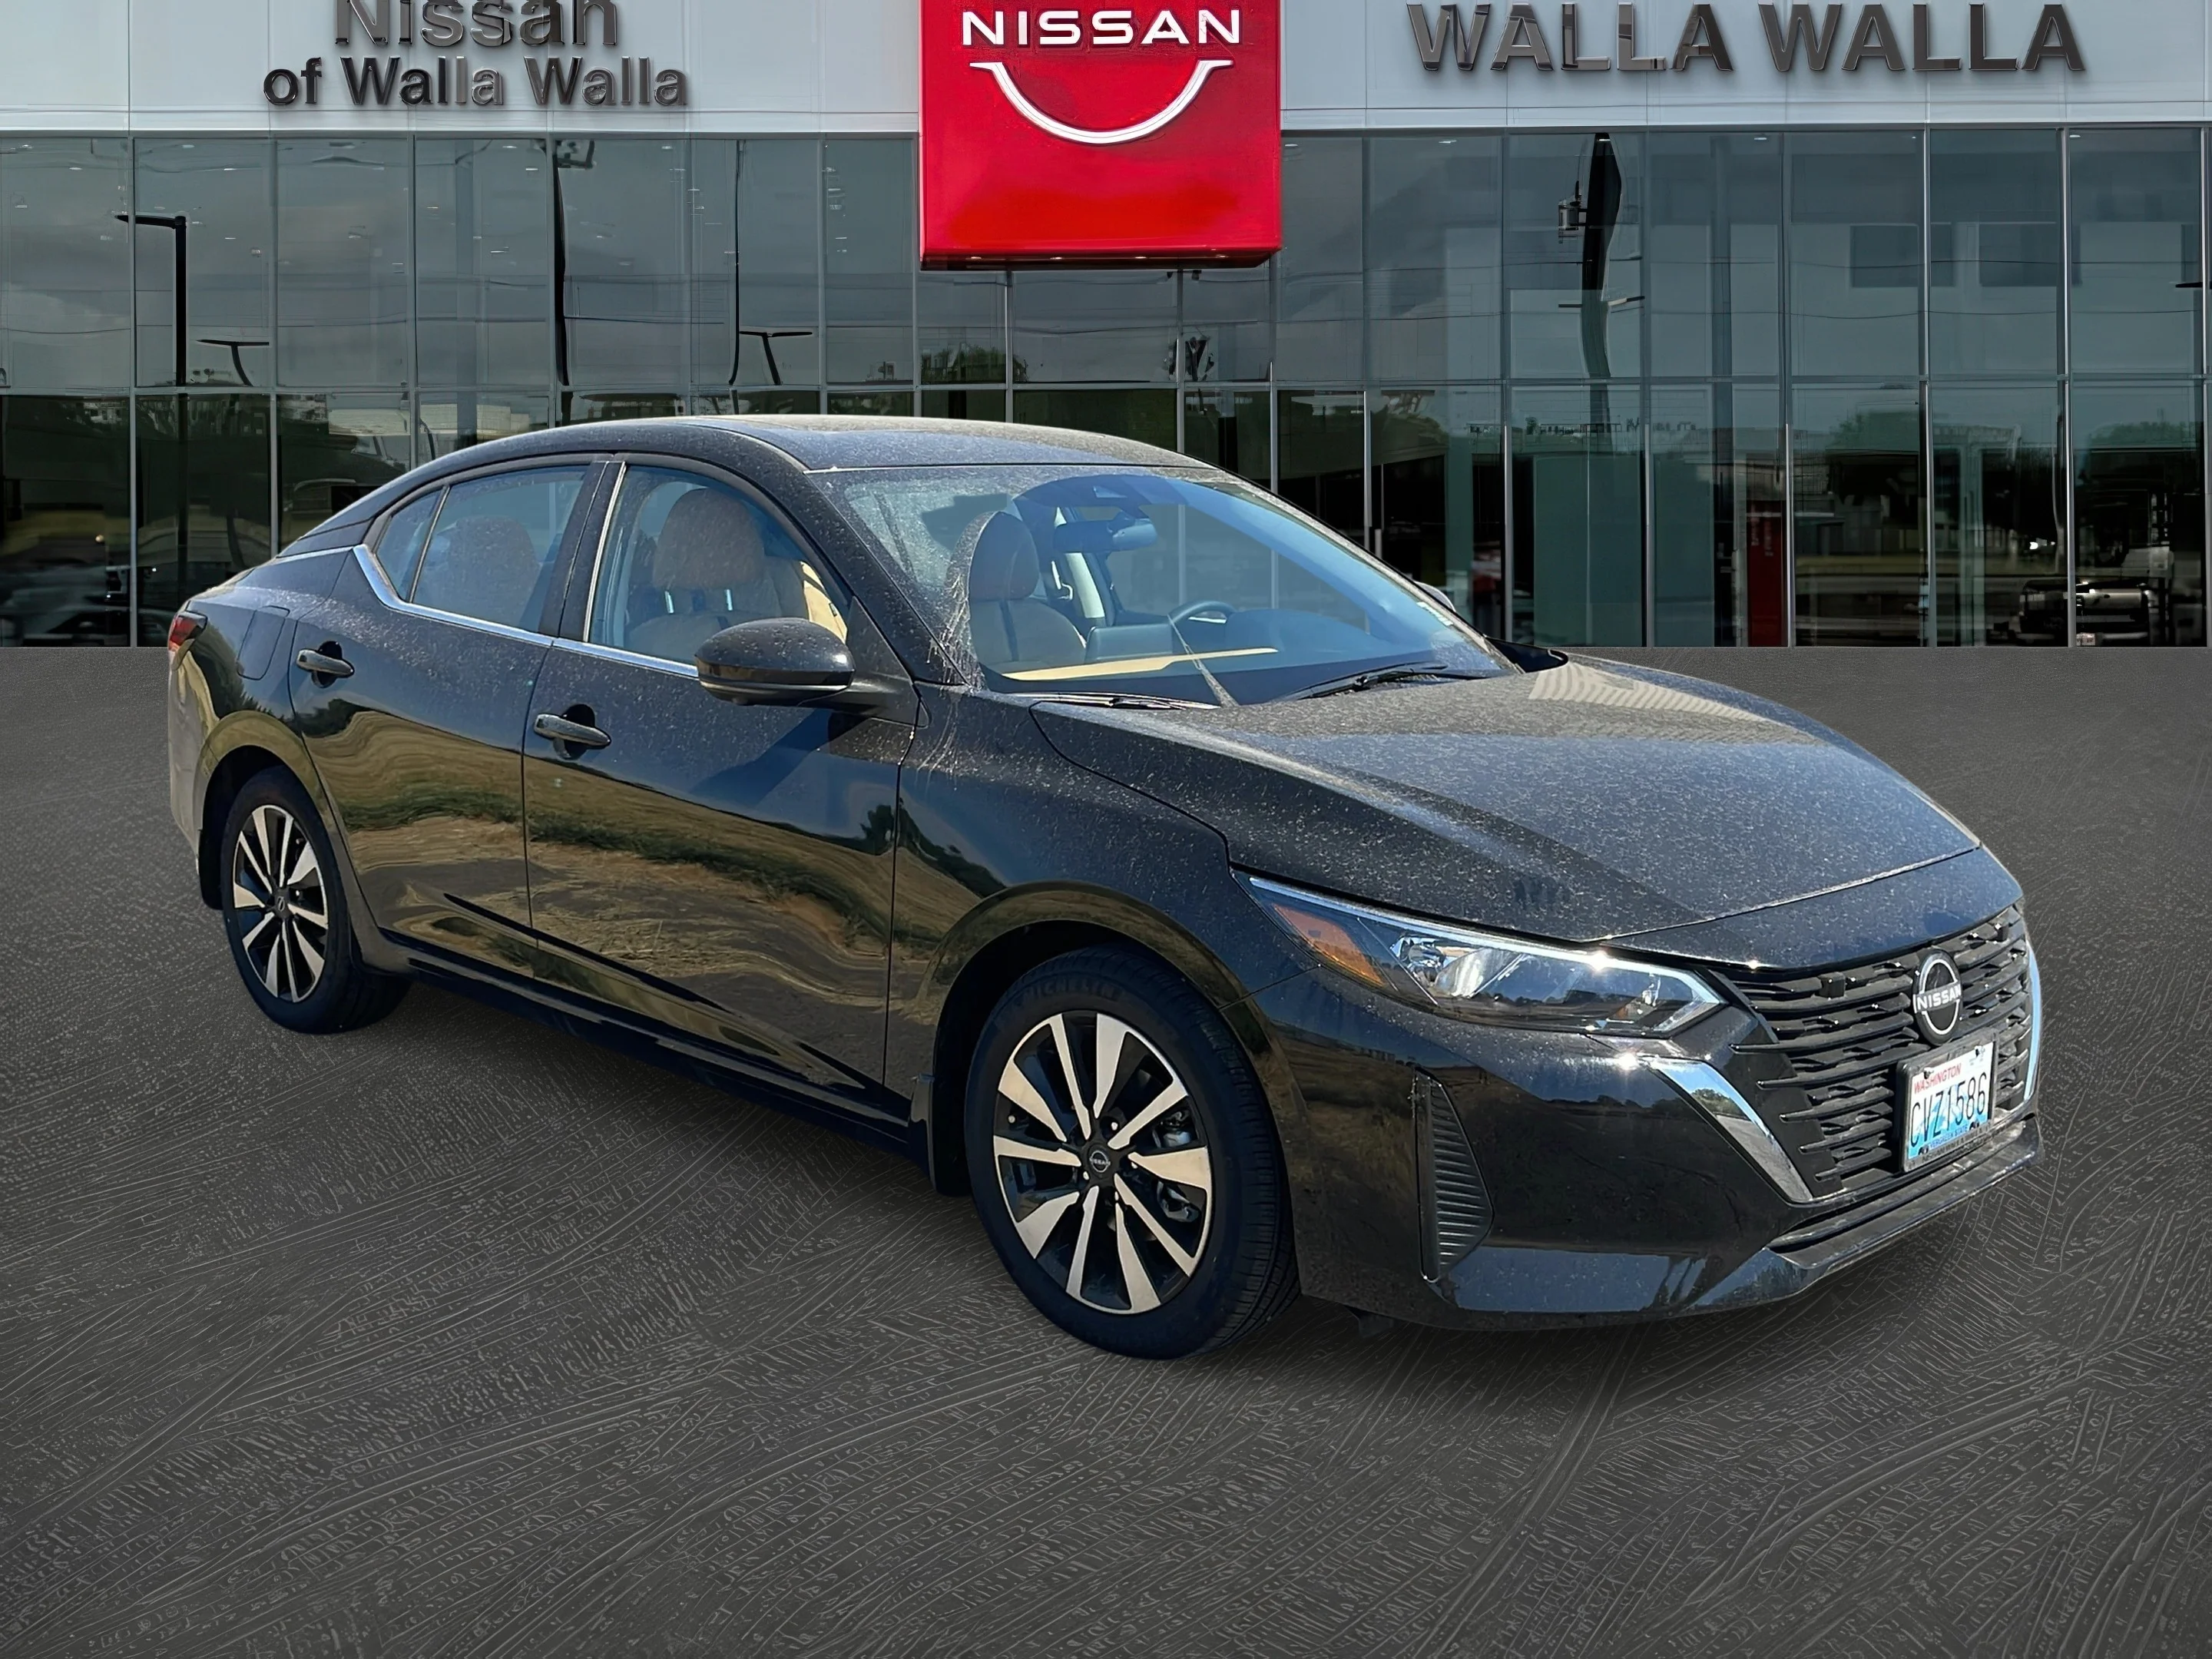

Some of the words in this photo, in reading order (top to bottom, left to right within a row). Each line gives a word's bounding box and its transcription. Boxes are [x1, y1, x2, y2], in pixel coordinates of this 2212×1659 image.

[962, 9, 1240, 45] NISSAN
[1407, 2, 1734, 72] WALLA
[1757, 2, 2085, 72] WALLA
[263, 56, 322, 105] of
[339, 55, 503, 106] Walla
[523, 55, 687, 106] Walla
[1915, 983, 1962, 1010] NISSAN
[1913, 1062, 1962, 1094] WASHINGTON
[1910, 1071, 1987, 1147] CVZ1586
